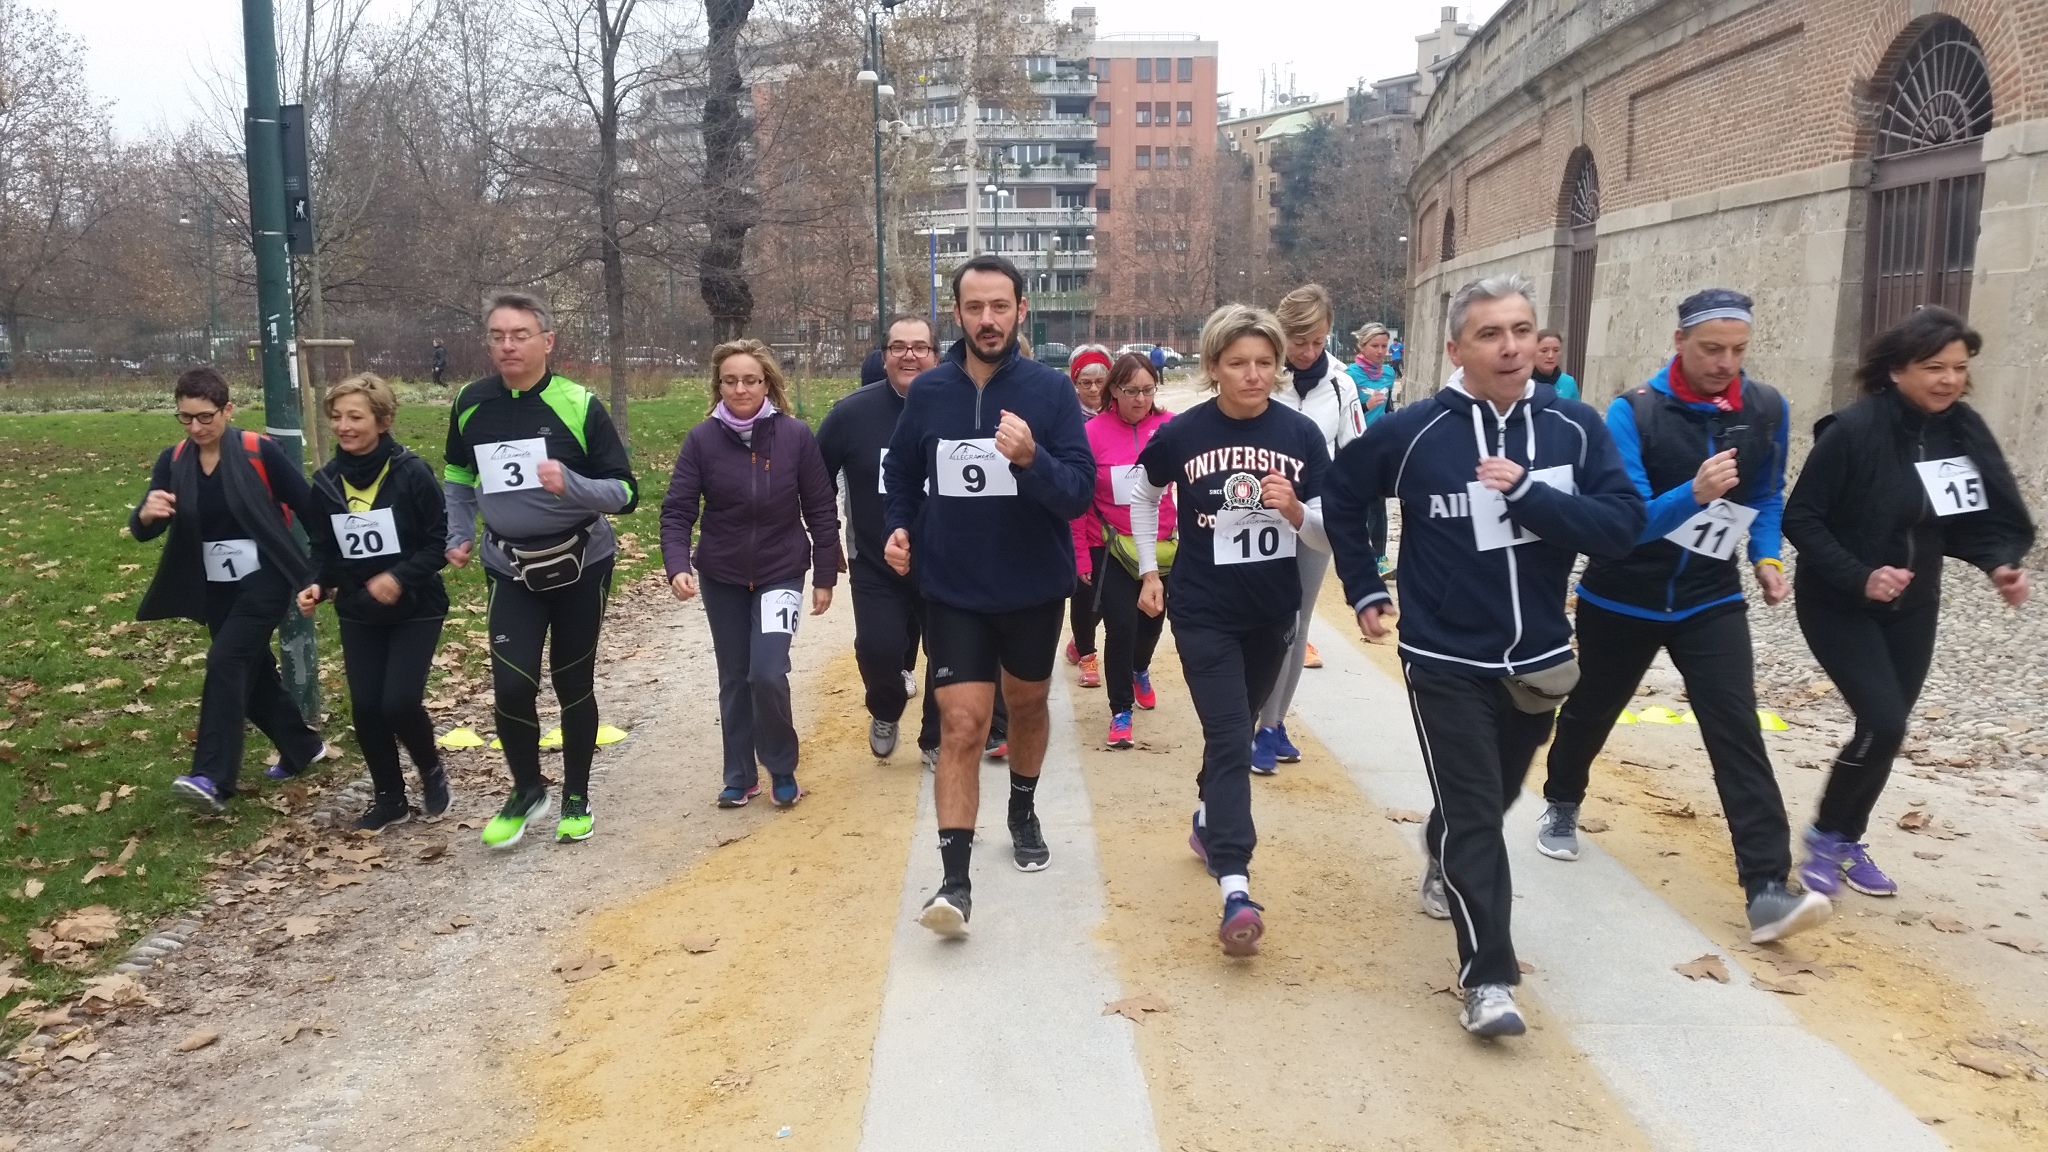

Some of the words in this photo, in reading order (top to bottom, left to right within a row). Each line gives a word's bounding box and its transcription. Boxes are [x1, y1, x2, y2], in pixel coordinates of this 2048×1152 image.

[502, 462, 524, 487] 3
[962, 464, 987, 493] 9
[1184, 447, 1304, 485] UNIVERSITY
[1429, 493, 1471, 518] All
[1944, 477, 1979, 509] 15
[1498, 511, 1522, 539] 1
[1693, 521, 1730, 553] 11
[345, 530, 384, 556] 20
[1233, 526, 1280, 558] 10
[222, 558, 237, 578] 1
[776, 607, 799, 634] 16
